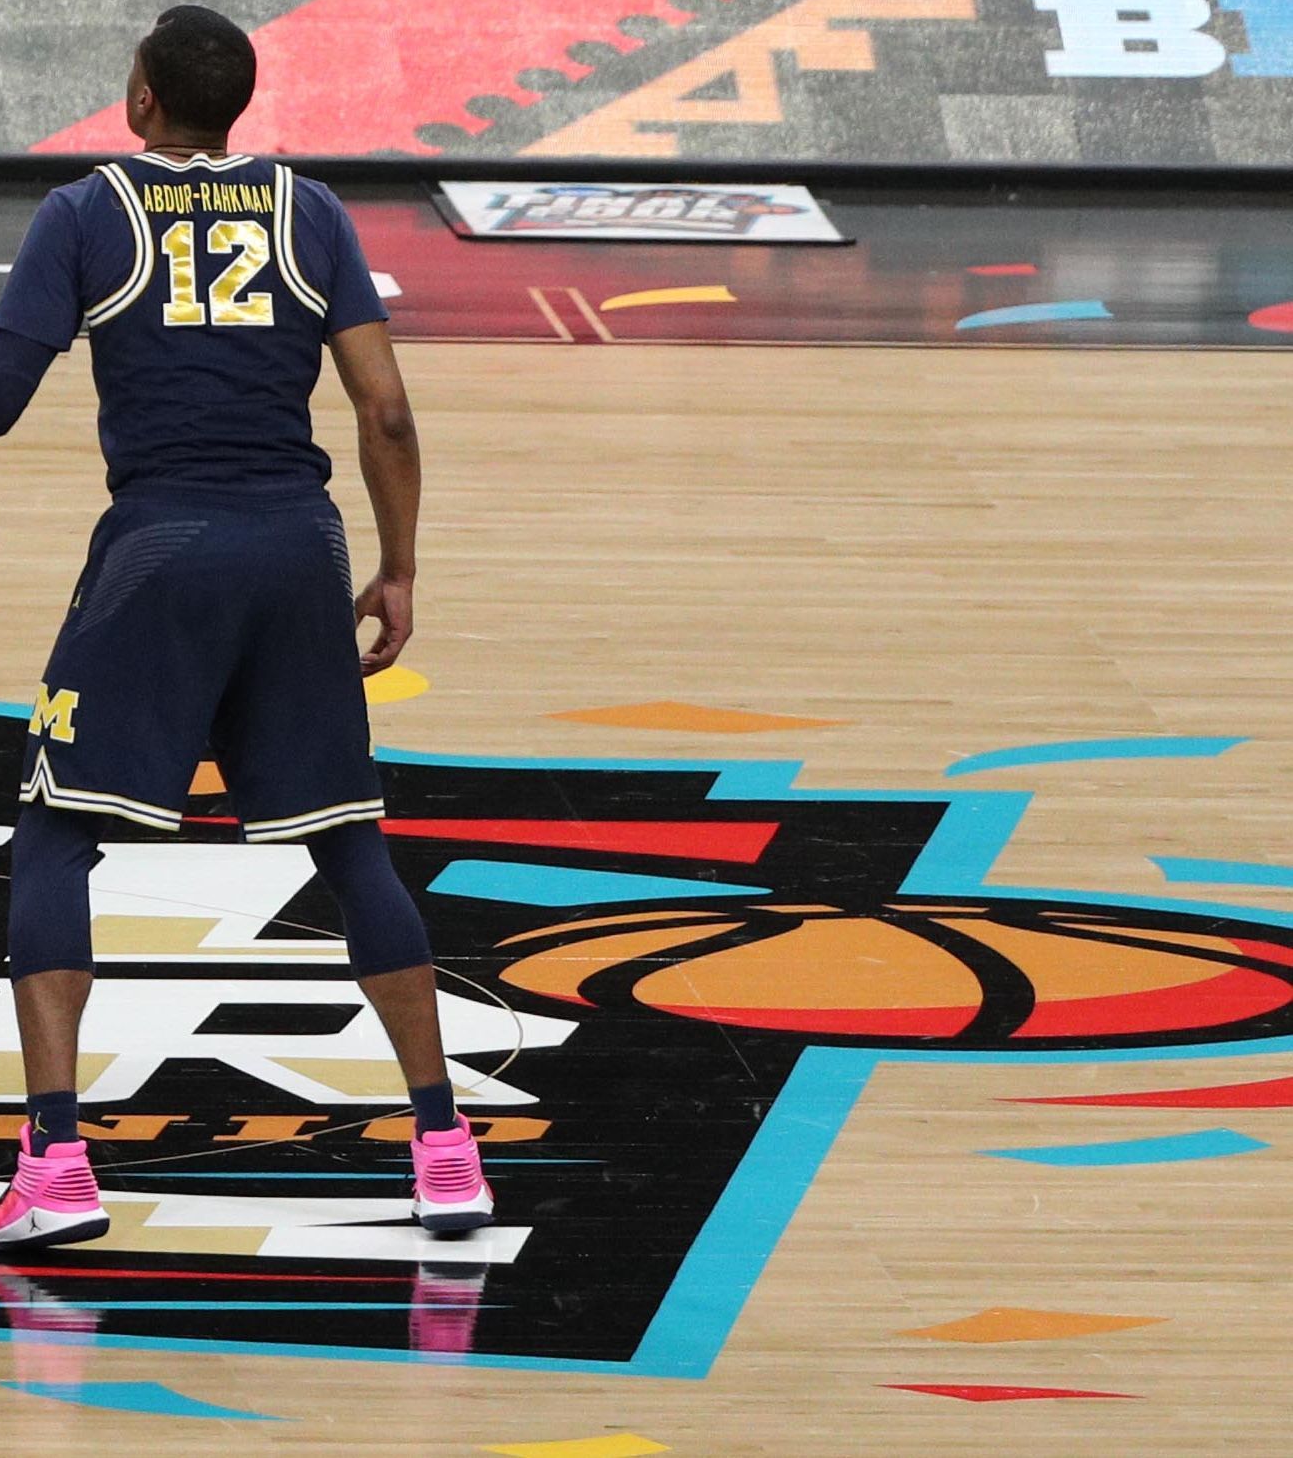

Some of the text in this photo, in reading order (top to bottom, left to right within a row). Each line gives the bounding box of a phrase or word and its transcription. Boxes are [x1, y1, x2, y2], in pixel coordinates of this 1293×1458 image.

[143, 182, 274, 214] ABDUR-RAHKMAN
[161, 220, 275, 327] 12
[27, 682, 80, 744] M
